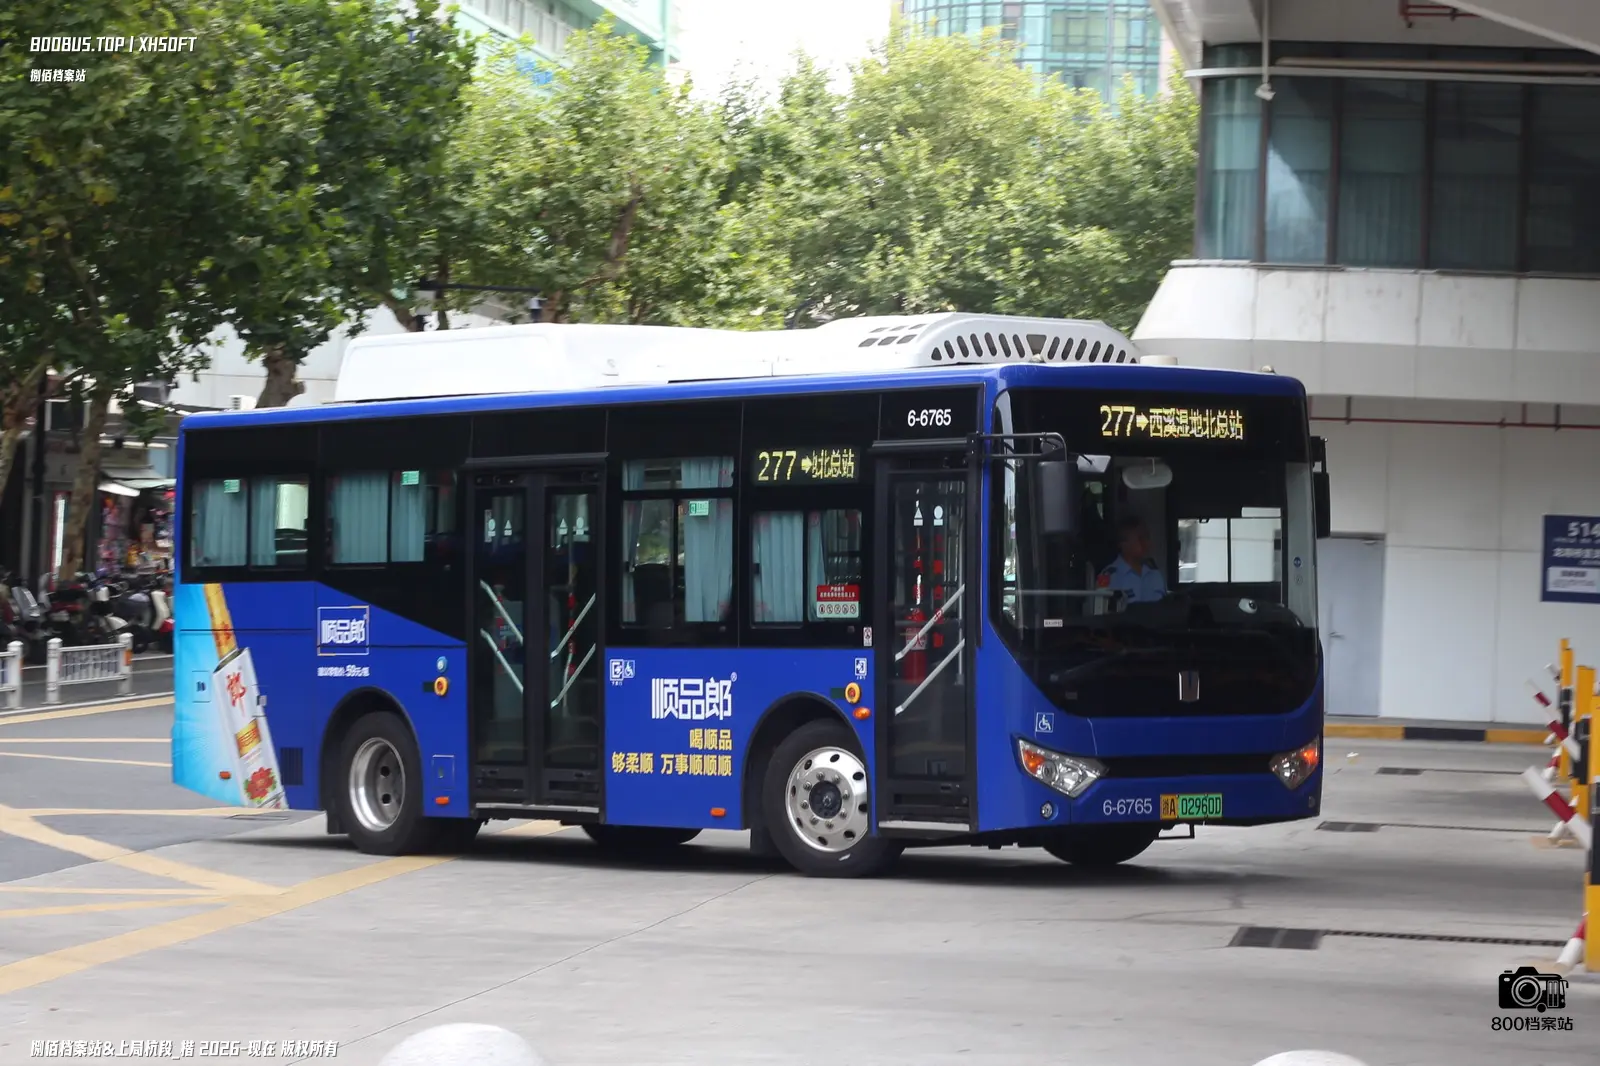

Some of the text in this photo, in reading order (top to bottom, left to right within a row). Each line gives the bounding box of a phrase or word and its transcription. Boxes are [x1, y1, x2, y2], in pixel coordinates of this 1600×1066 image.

[907, 409, 952, 427] 6-6765
[1100, 405, 1244, 440] 277 西溪湿地北总站
[758, 450, 797, 481] 277
[321, 618, 367, 644] 顺品郎
[651, 677, 732, 721] 顺品郎
[689, 728, 732, 751] 喝顺品
[611, 751, 732, 777] 够柔顺 万事顺顺顺
[1103, 798, 1153, 816] 6-6765
